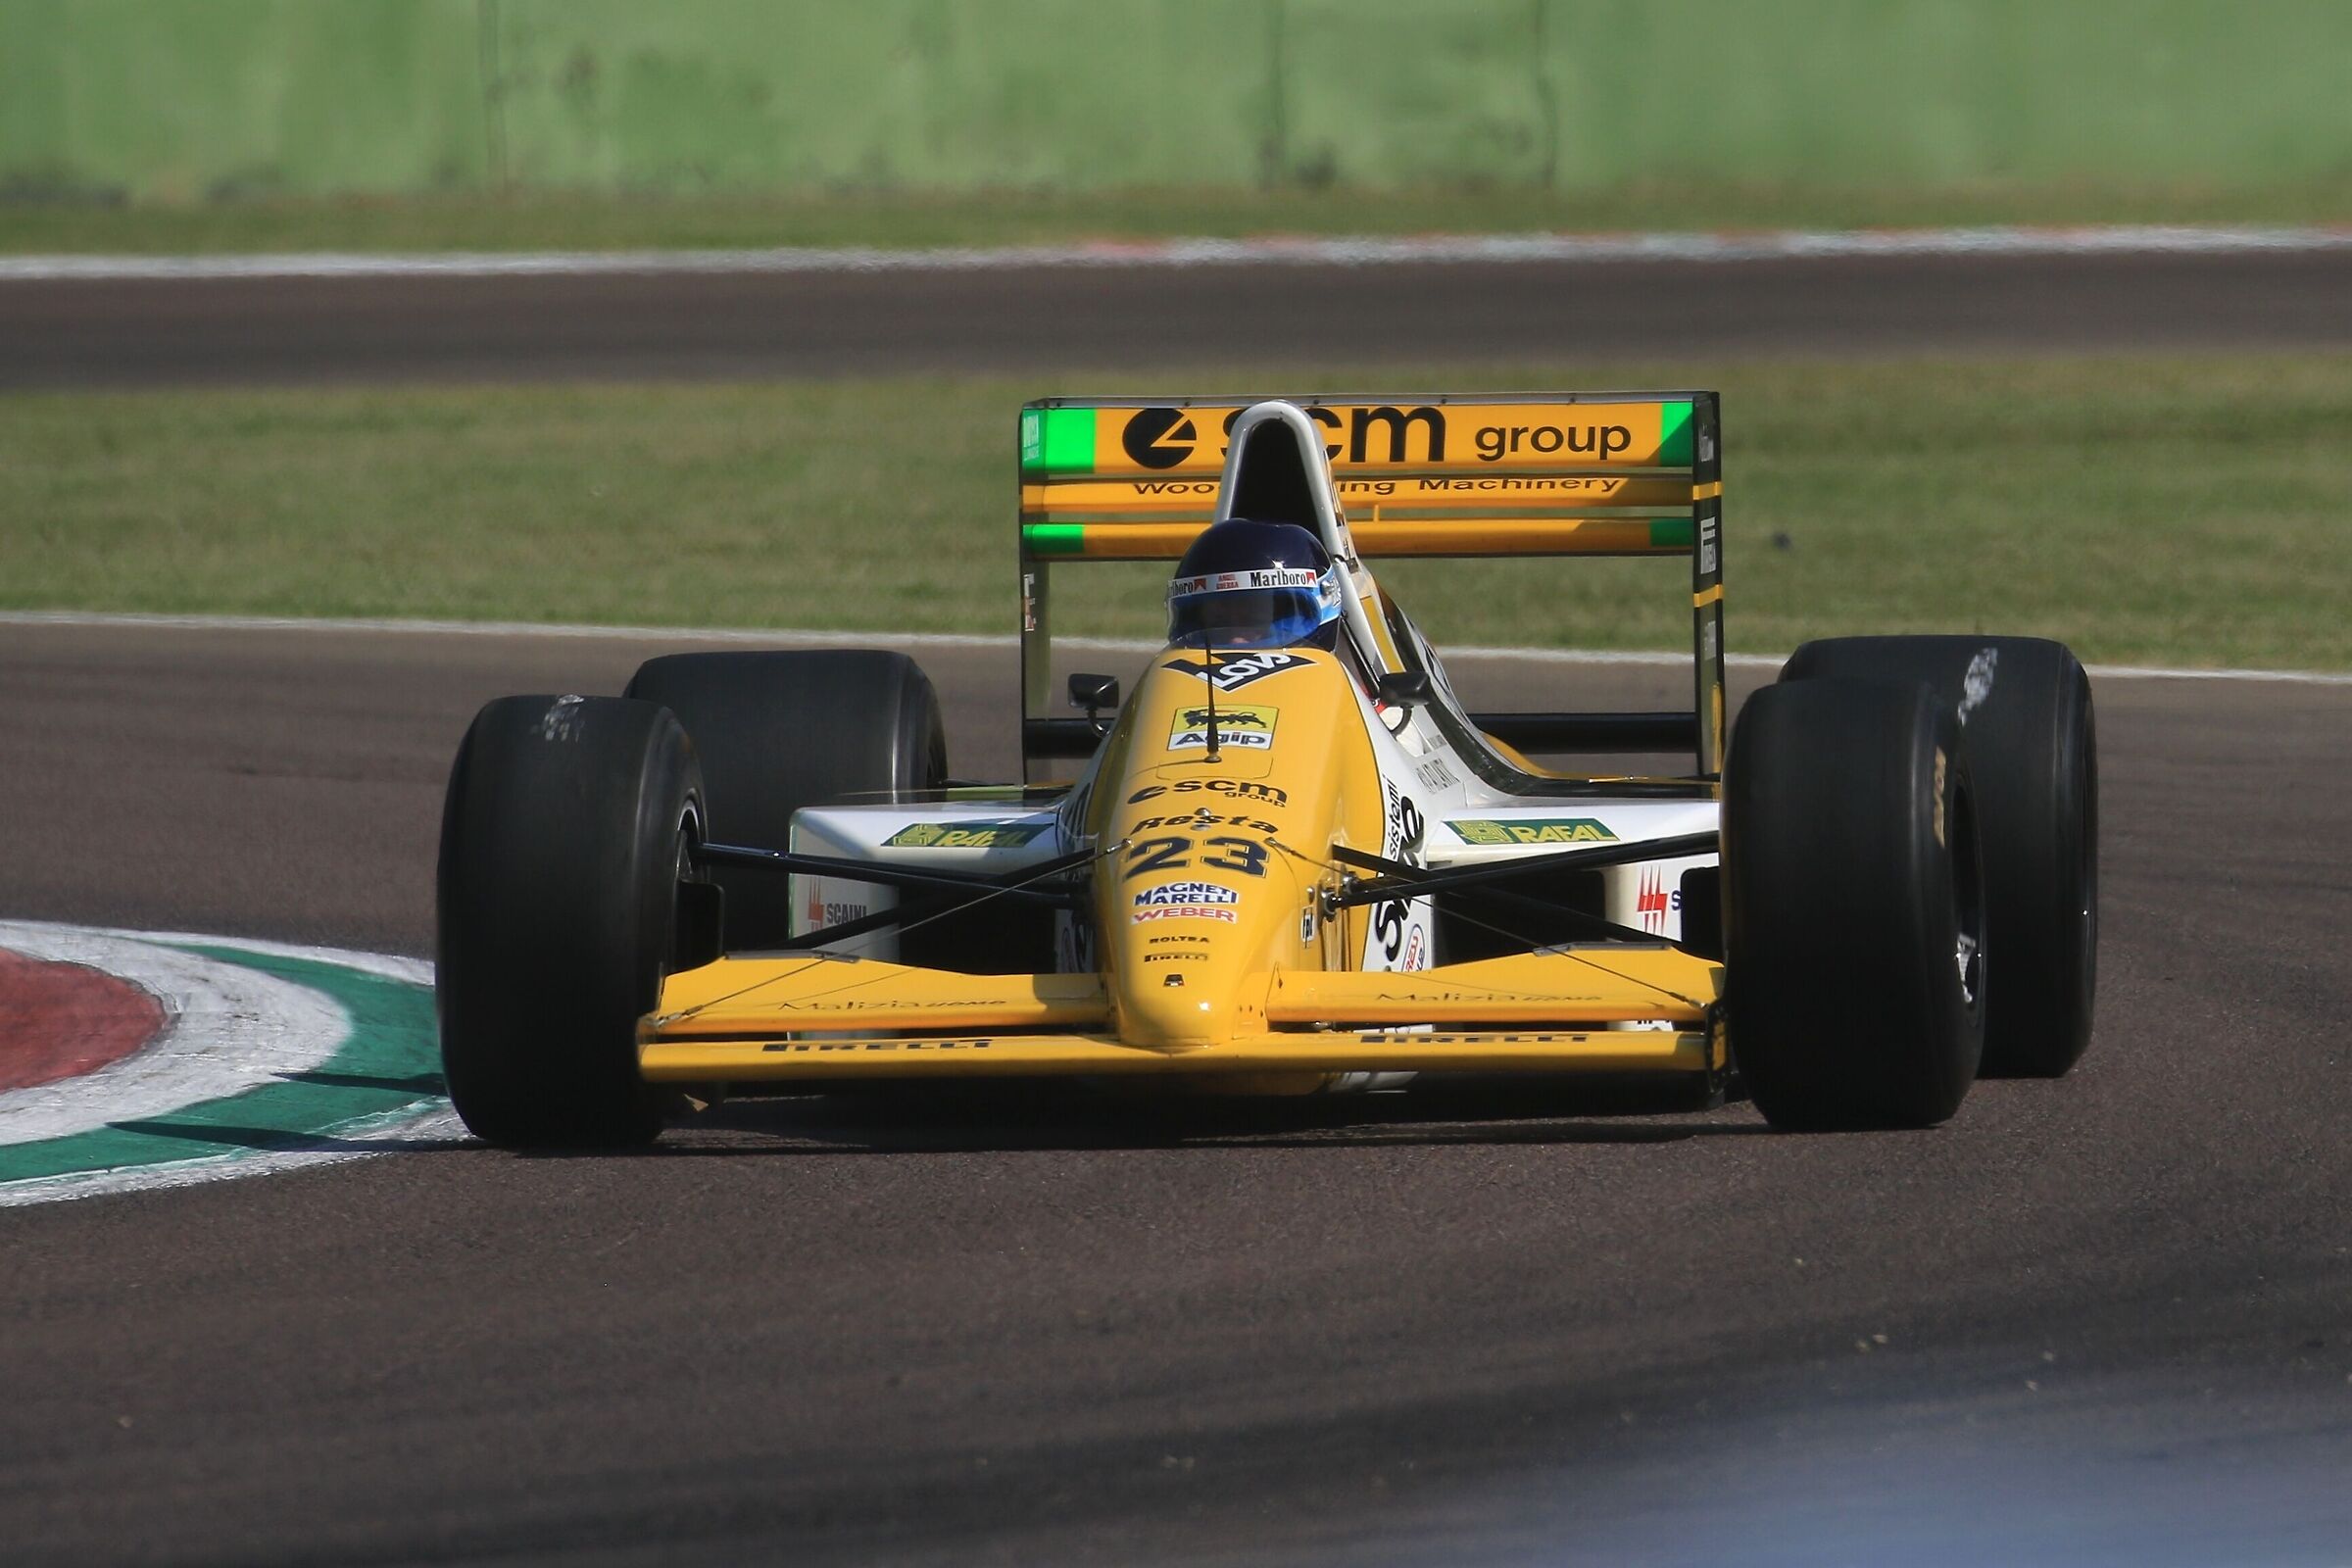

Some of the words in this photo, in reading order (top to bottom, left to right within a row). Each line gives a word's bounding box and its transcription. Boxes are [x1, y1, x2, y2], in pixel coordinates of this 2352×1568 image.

[1476, 424, 1631, 461] group
[1419, 478, 1619, 493] Machinery
[1250, 570, 1305, 588] Marlboro
[1176, 732, 1265, 745] Agip
[1173, 780, 1287, 804] scm
[1225, 791, 1286, 808] group
[1383, 775, 1400, 859] sistemi
[1508, 825, 1610, 843] RAFAL
[1123, 836, 1270, 880] 23
[1136, 891, 1237, 906] MARELLI
[1134, 907, 1235, 922] WEBER
[762, 1039, 992, 1053] PIRELLI
[1360, 1033, 1589, 1044] PIRELLI
